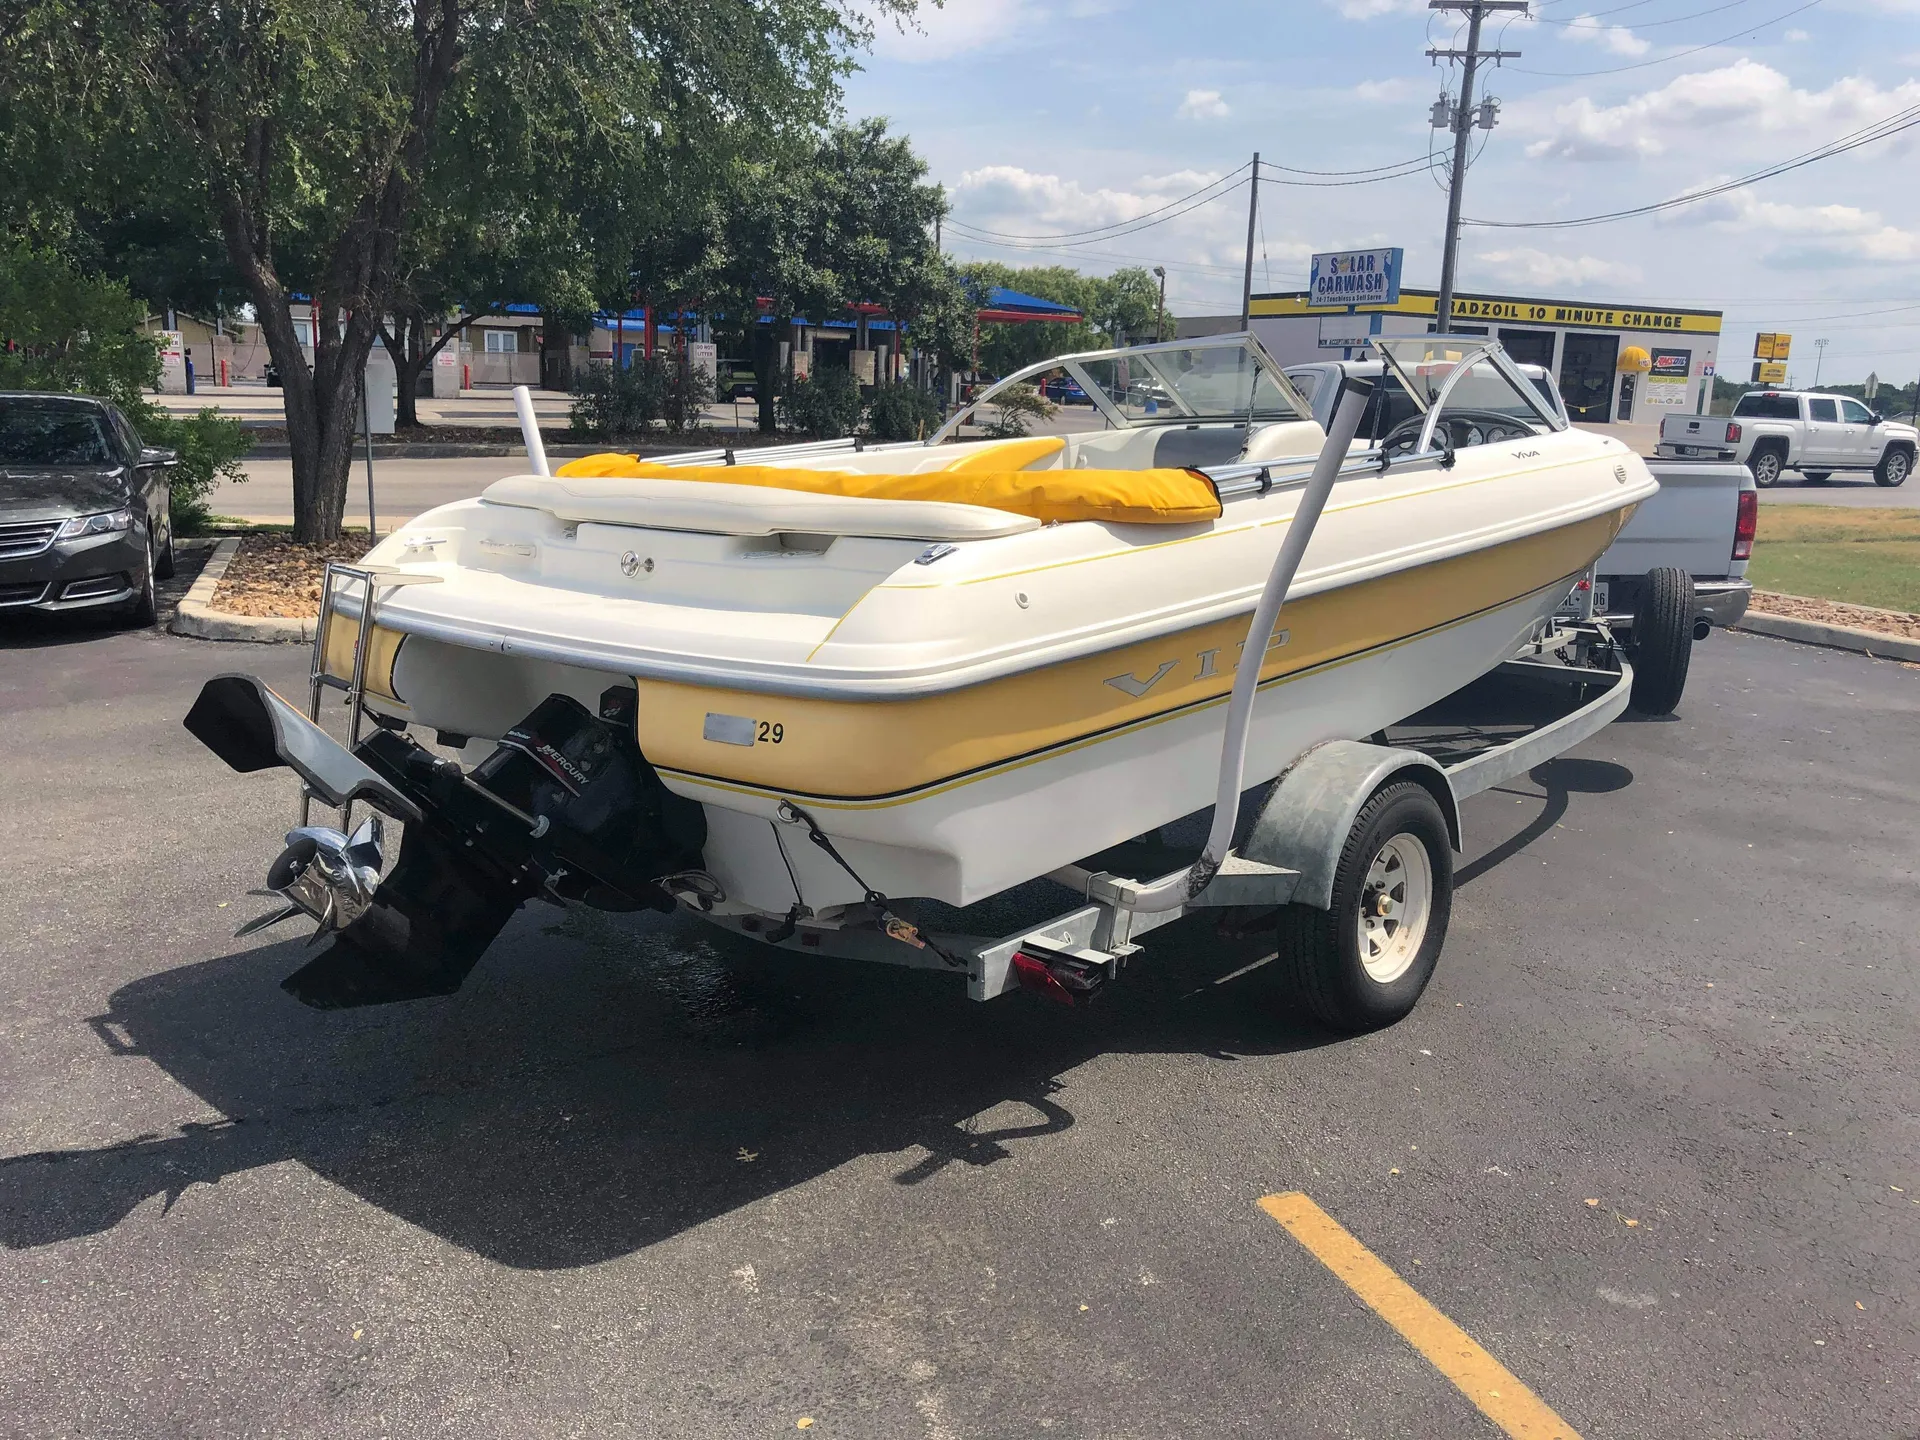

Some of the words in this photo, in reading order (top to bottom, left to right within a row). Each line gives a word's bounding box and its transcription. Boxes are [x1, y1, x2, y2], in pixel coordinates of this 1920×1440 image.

[1317, 272, 1384, 295] CARWASH
[1528, 306, 1546, 320] 10
[1555, 308, 1614, 324] MINUTE
[1622, 312, 1683, 328] CHANGE
[1653, 355, 1687, 368] AMSOIL
[757, 721, 784, 744] 29
[541, 744, 590, 785] MERCURY
